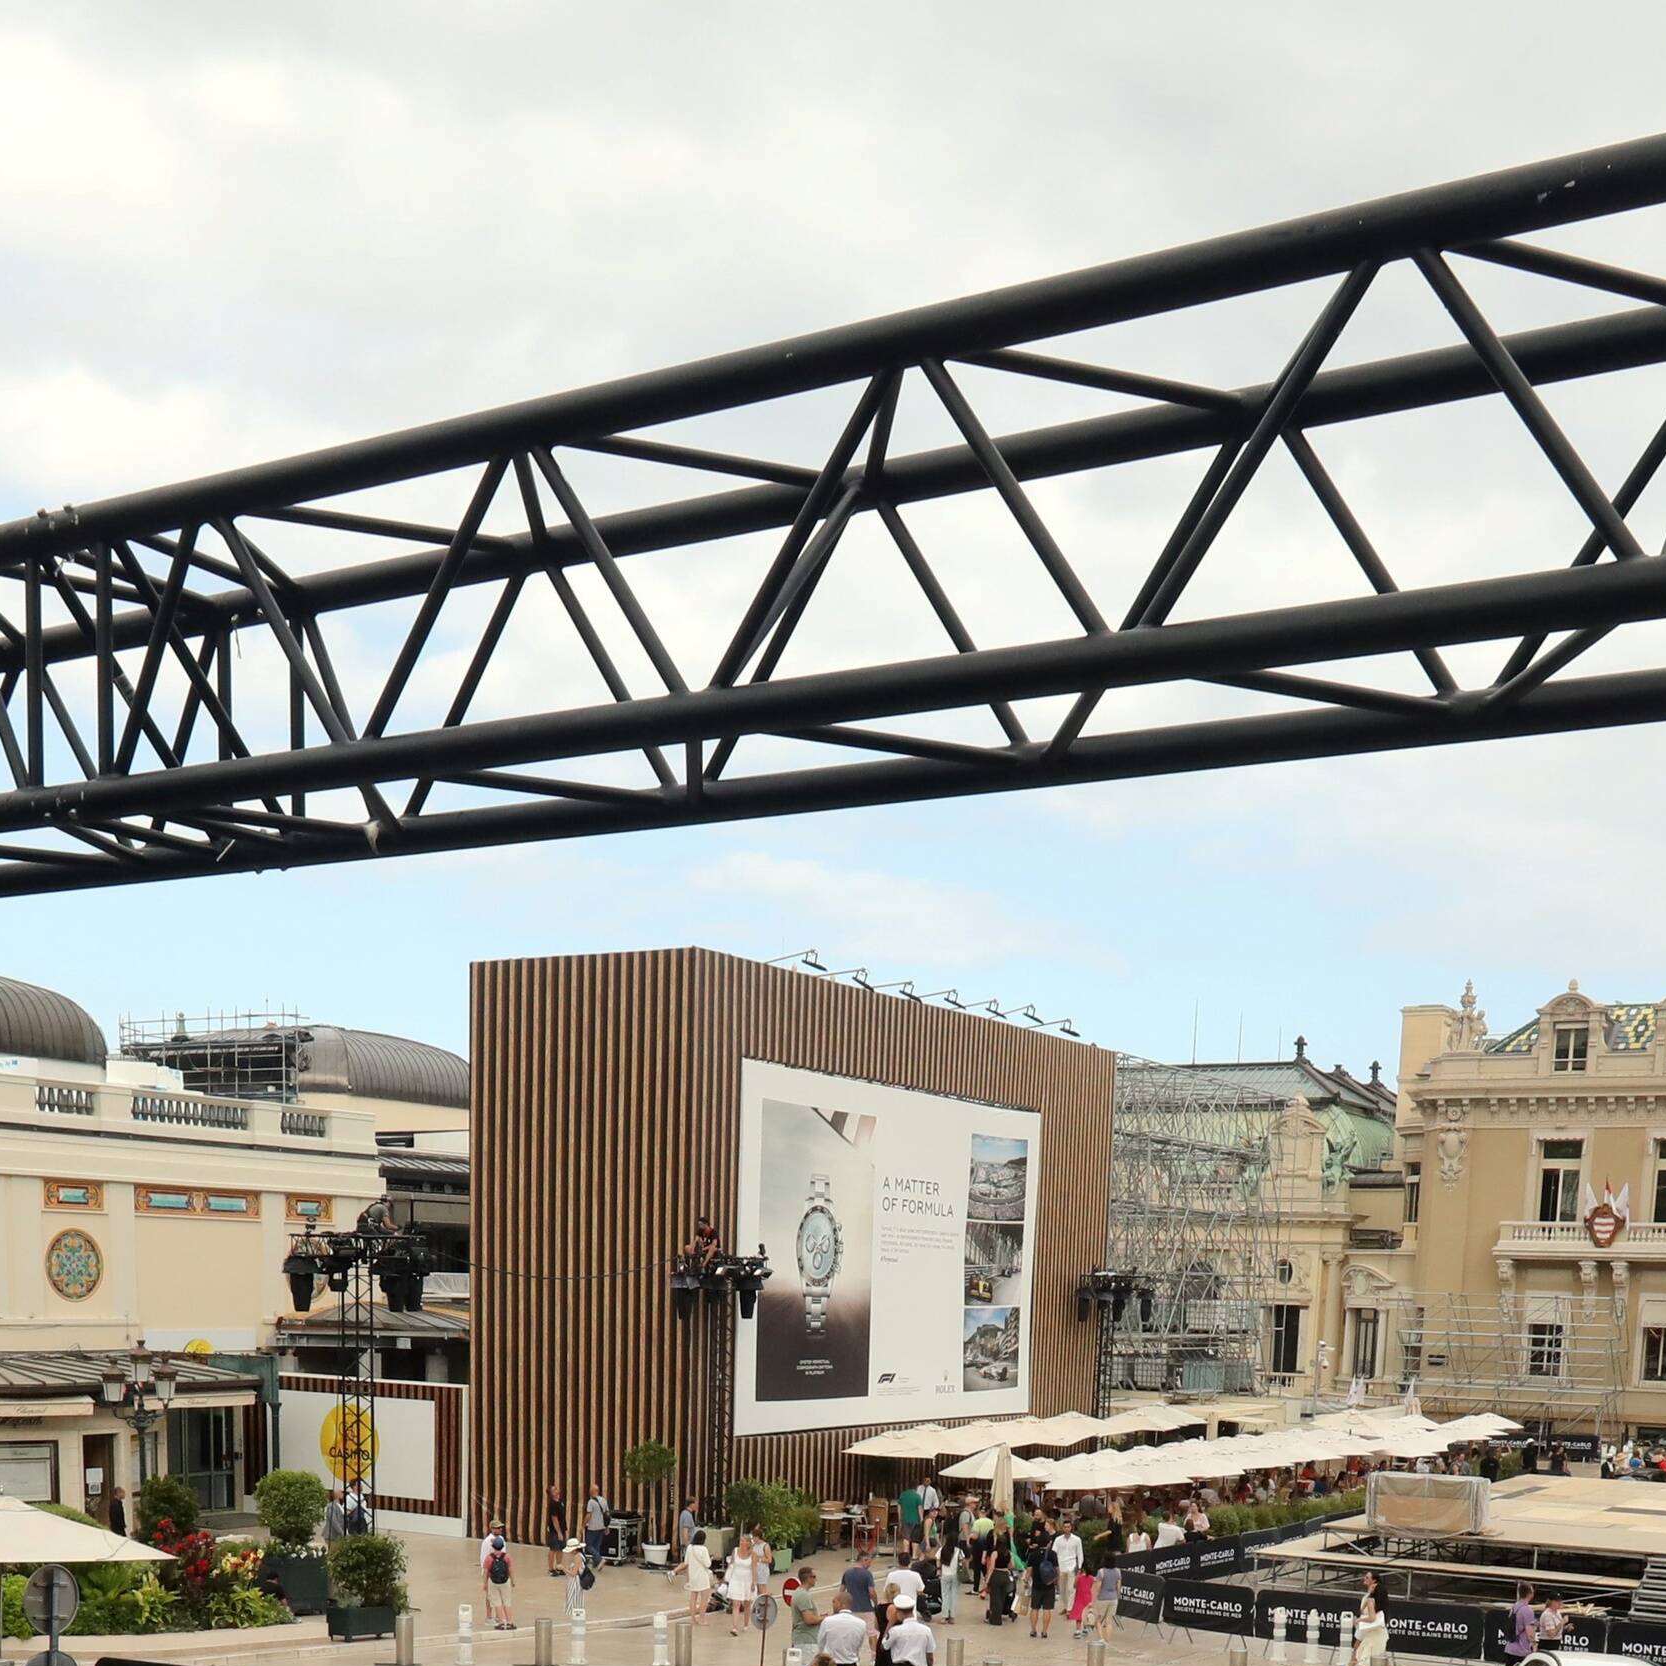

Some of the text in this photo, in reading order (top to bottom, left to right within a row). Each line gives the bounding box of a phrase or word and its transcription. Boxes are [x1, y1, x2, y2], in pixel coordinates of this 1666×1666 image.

[882, 1176, 940, 1197] A MATTER
[882, 1196, 954, 1217] OF FORMULA
[935, 1385, 956, 1394] ROLEX
